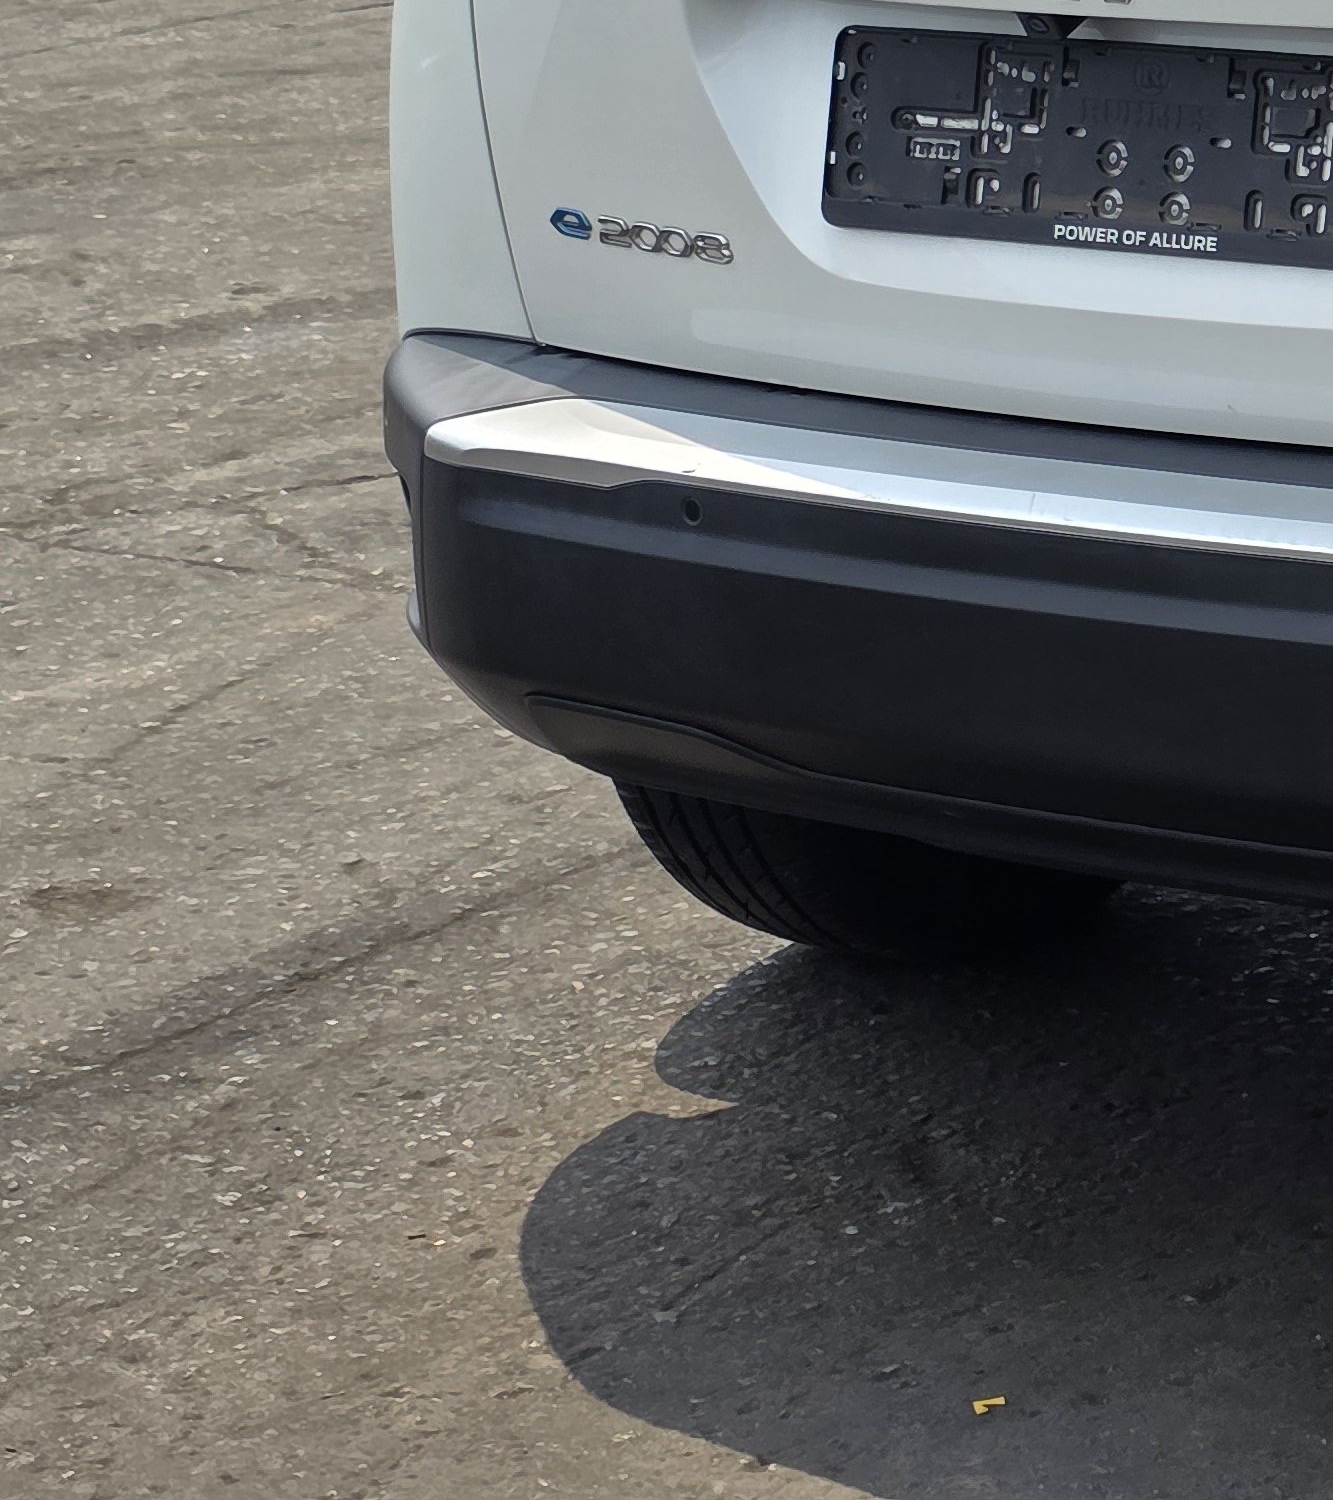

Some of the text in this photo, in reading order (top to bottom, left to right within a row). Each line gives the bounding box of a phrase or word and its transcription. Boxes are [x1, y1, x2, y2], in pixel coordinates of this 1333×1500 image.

[1053, 224, 1218, 252] POWER OF ALLURE
